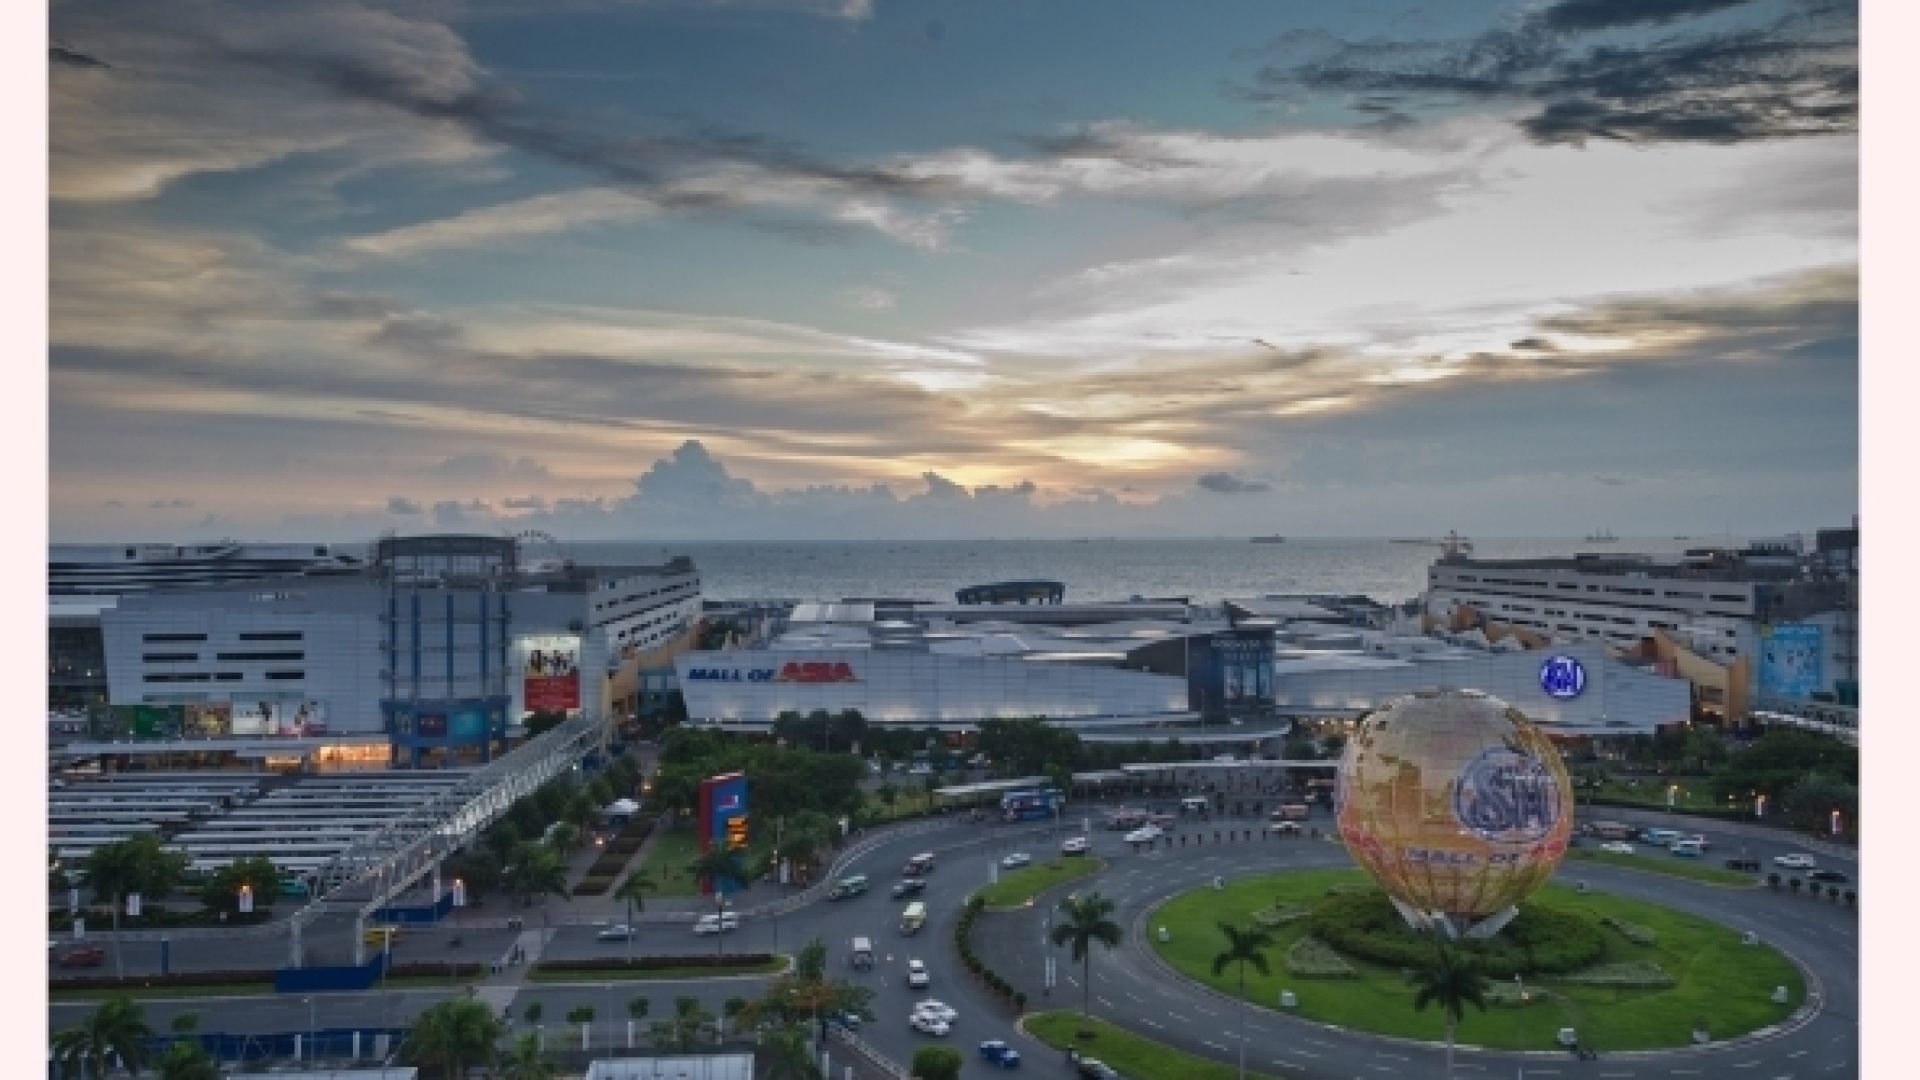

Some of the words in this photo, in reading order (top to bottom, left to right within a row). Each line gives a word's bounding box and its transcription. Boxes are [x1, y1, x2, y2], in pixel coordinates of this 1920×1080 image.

[688, 667, 741, 681] MALL
[746, 667, 776, 681] OF
[781, 661, 856, 683] ASIA
[1464, 757, 1553, 835] SM
[1407, 847, 1475, 863] MALL
